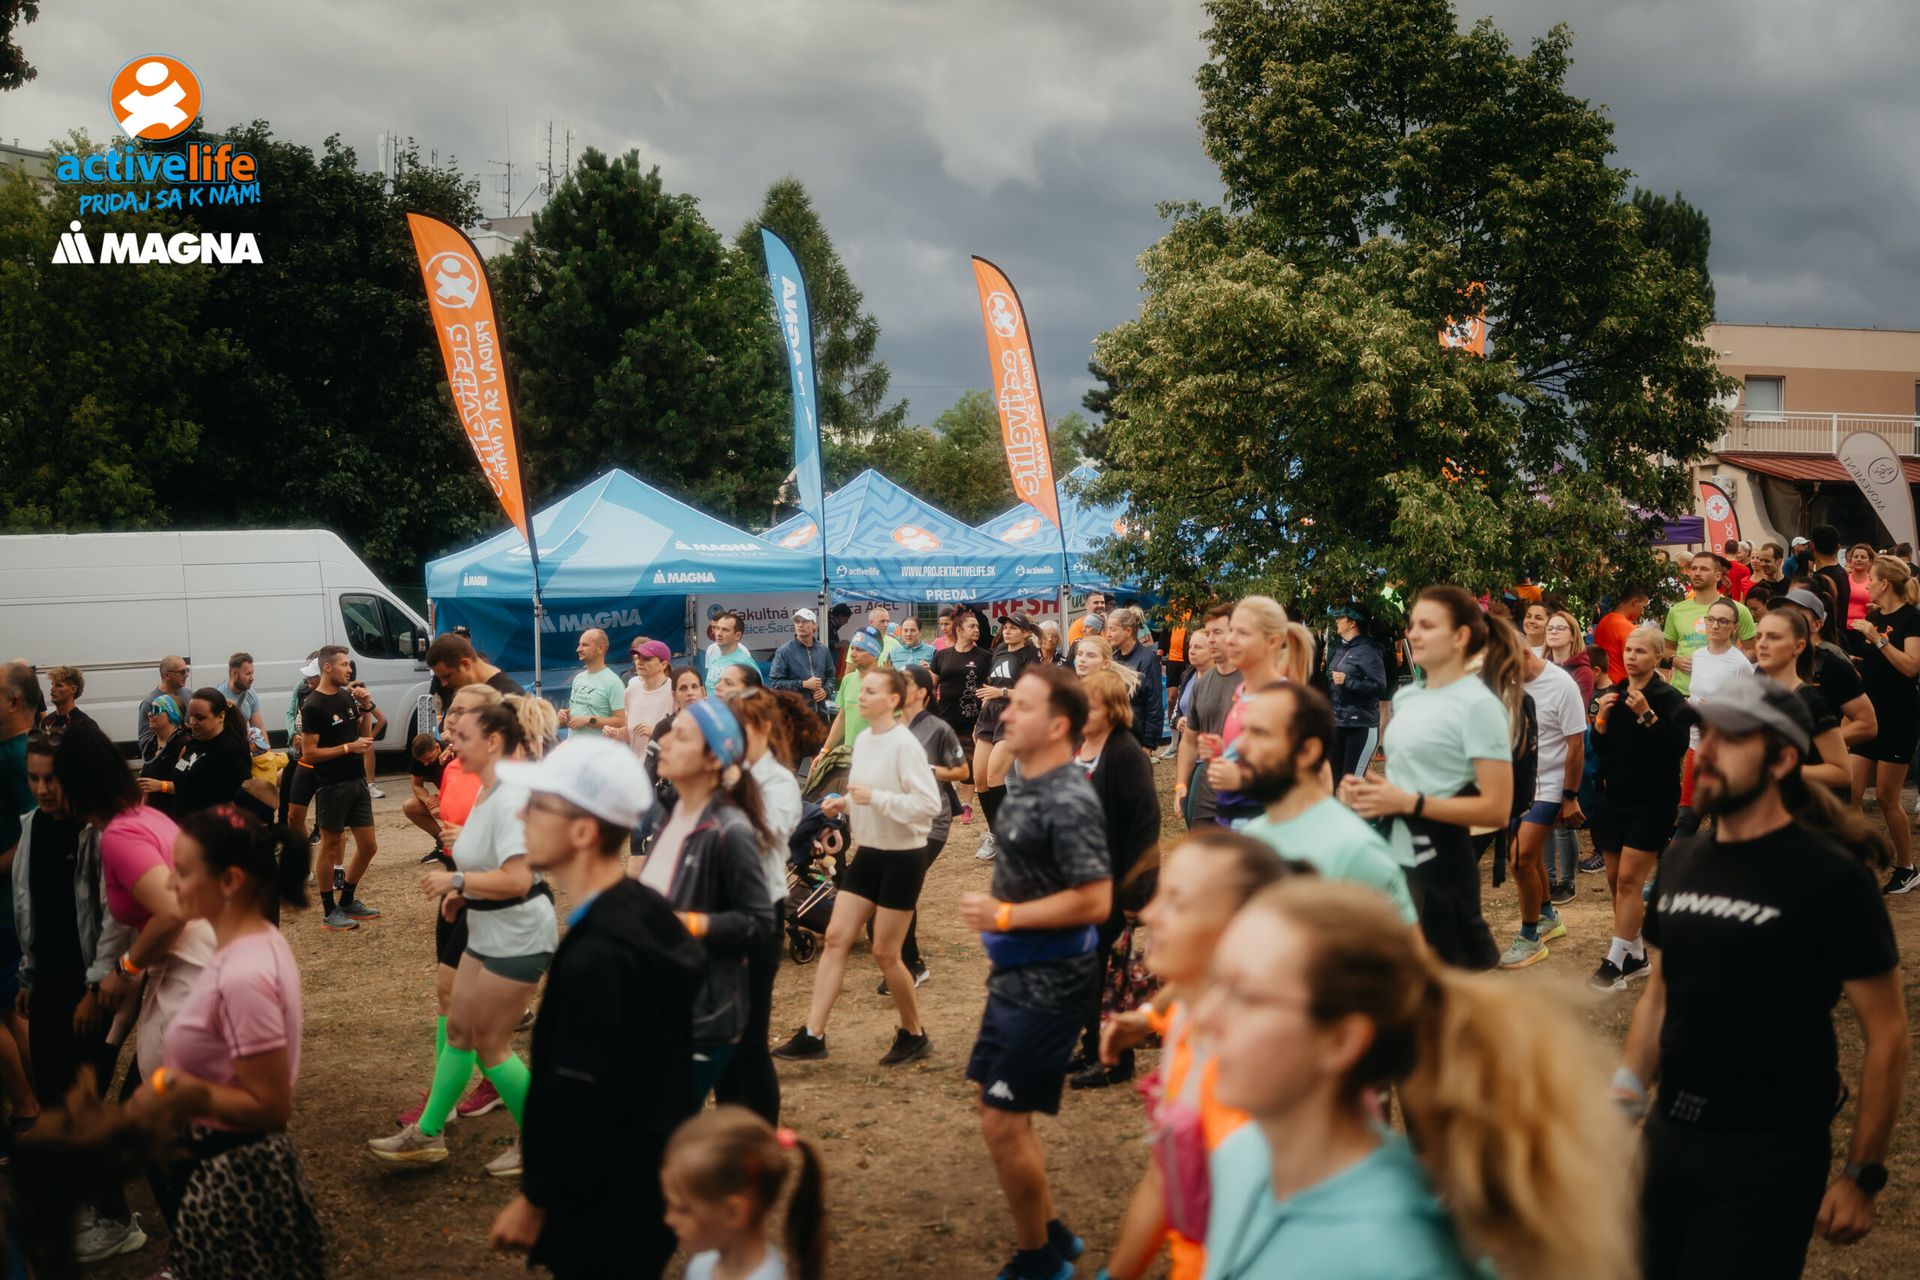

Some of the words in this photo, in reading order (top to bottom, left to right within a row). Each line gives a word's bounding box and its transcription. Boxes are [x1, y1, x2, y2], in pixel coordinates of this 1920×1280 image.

[901, 565, 996, 577] WWW.PROJEKTACTIVELIFE.SK
[667, 572, 716, 583] MAGNA
[925, 589, 977, 600] PREDAJ
[559, 608, 643, 632] MAGNA
